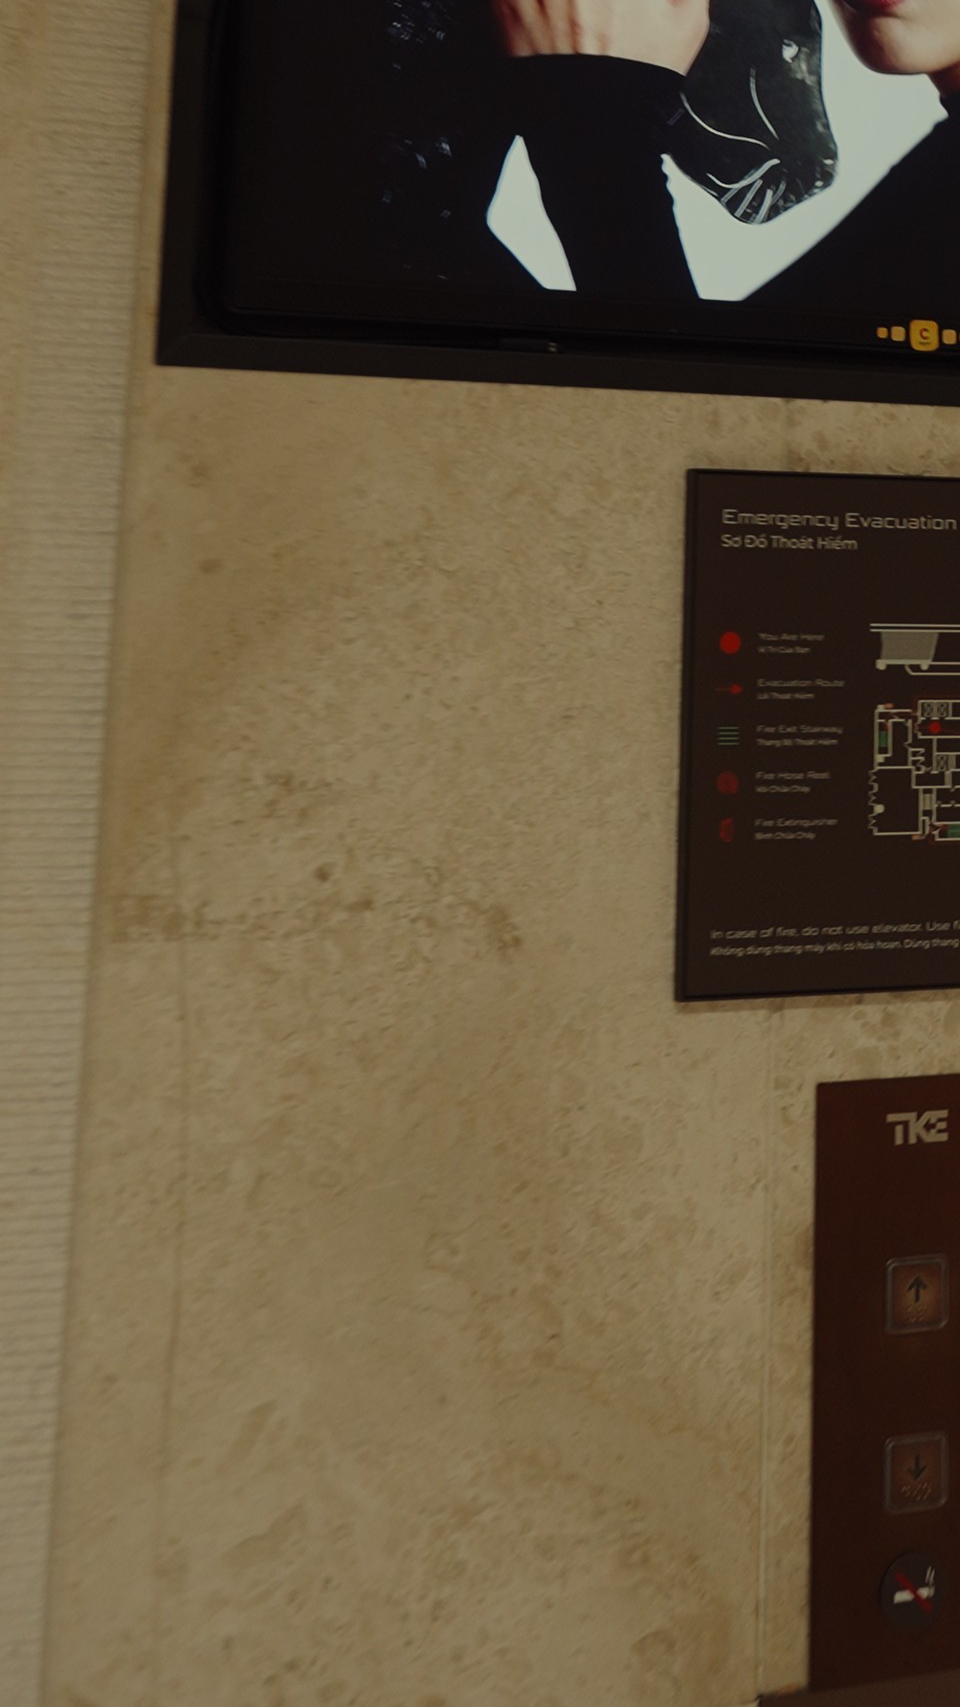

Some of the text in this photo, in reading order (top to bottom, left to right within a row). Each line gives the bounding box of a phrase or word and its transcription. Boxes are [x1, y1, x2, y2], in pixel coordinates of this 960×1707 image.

[722, 508, 839, 533] Emergency
[845, 511, 958, 531] Evacuation
[725, 929, 758, 939] case
[759, 926, 776, 938] of
[801, 926, 820, 936] do
[821, 925, 844, 935] not
[846, 925, 870, 935] use
[925, 920, 951, 932] Use
[886, 1109, 949, 1146] TKE
